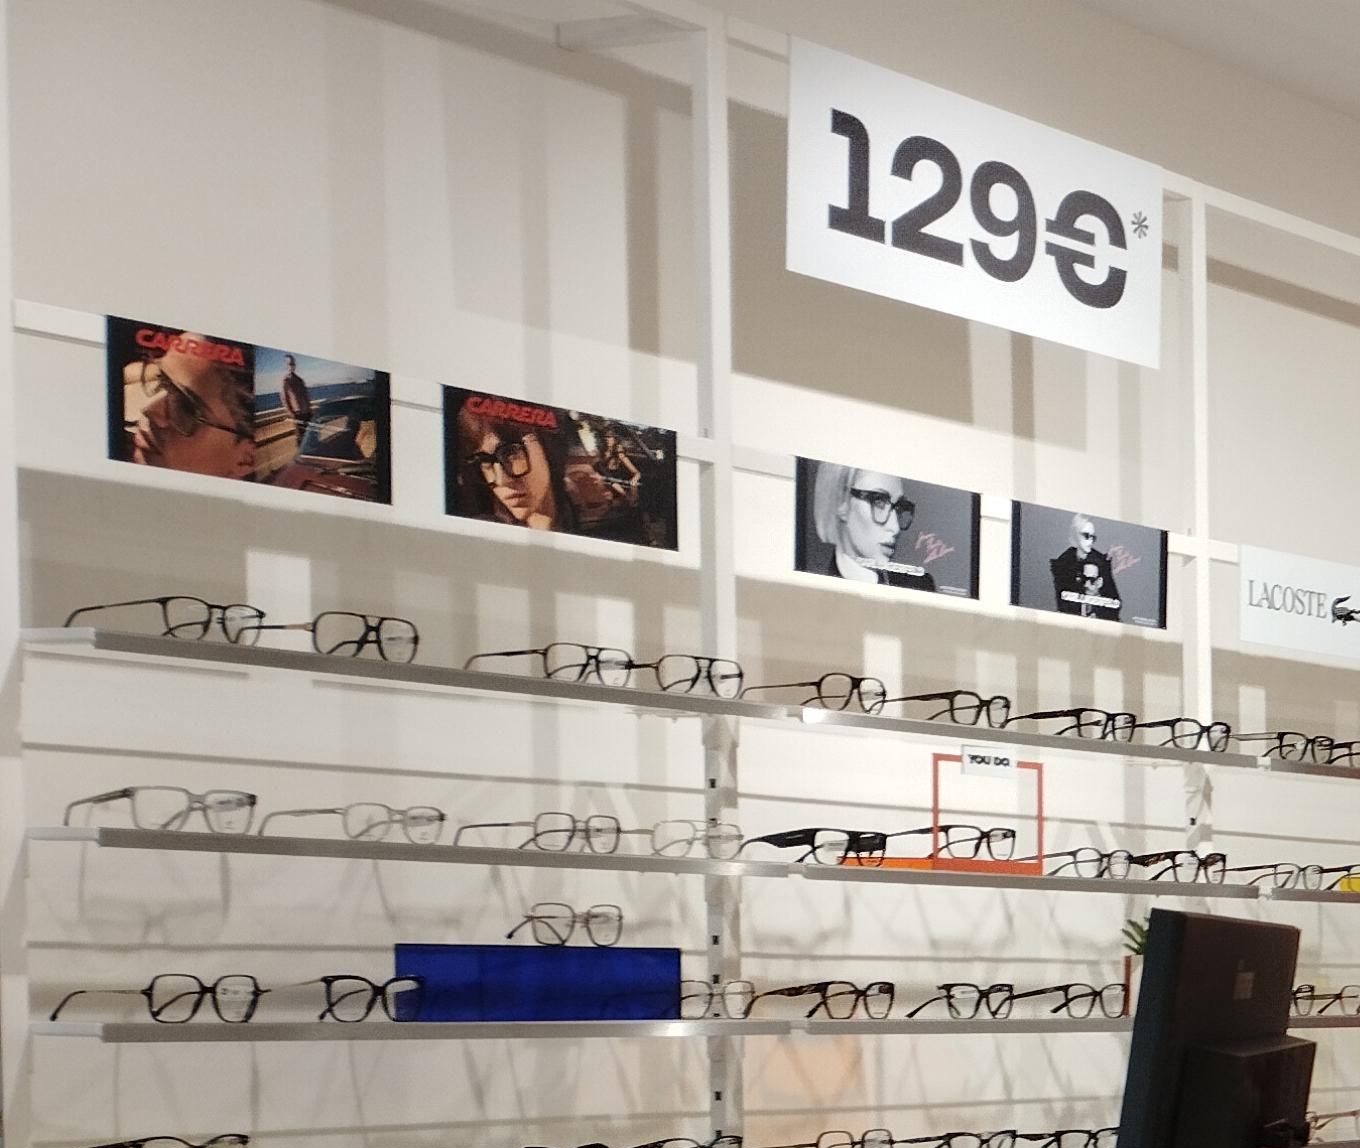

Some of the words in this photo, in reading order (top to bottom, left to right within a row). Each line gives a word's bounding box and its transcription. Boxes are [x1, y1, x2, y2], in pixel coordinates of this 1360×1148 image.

[135, 328, 245, 367] CARRERA
[465, 396, 557, 429] CARRERA
[1248, 579, 1328, 619] LACOSTE
[967, 753, 992, 765] YOU
[993, 756, 1011, 768] DO
